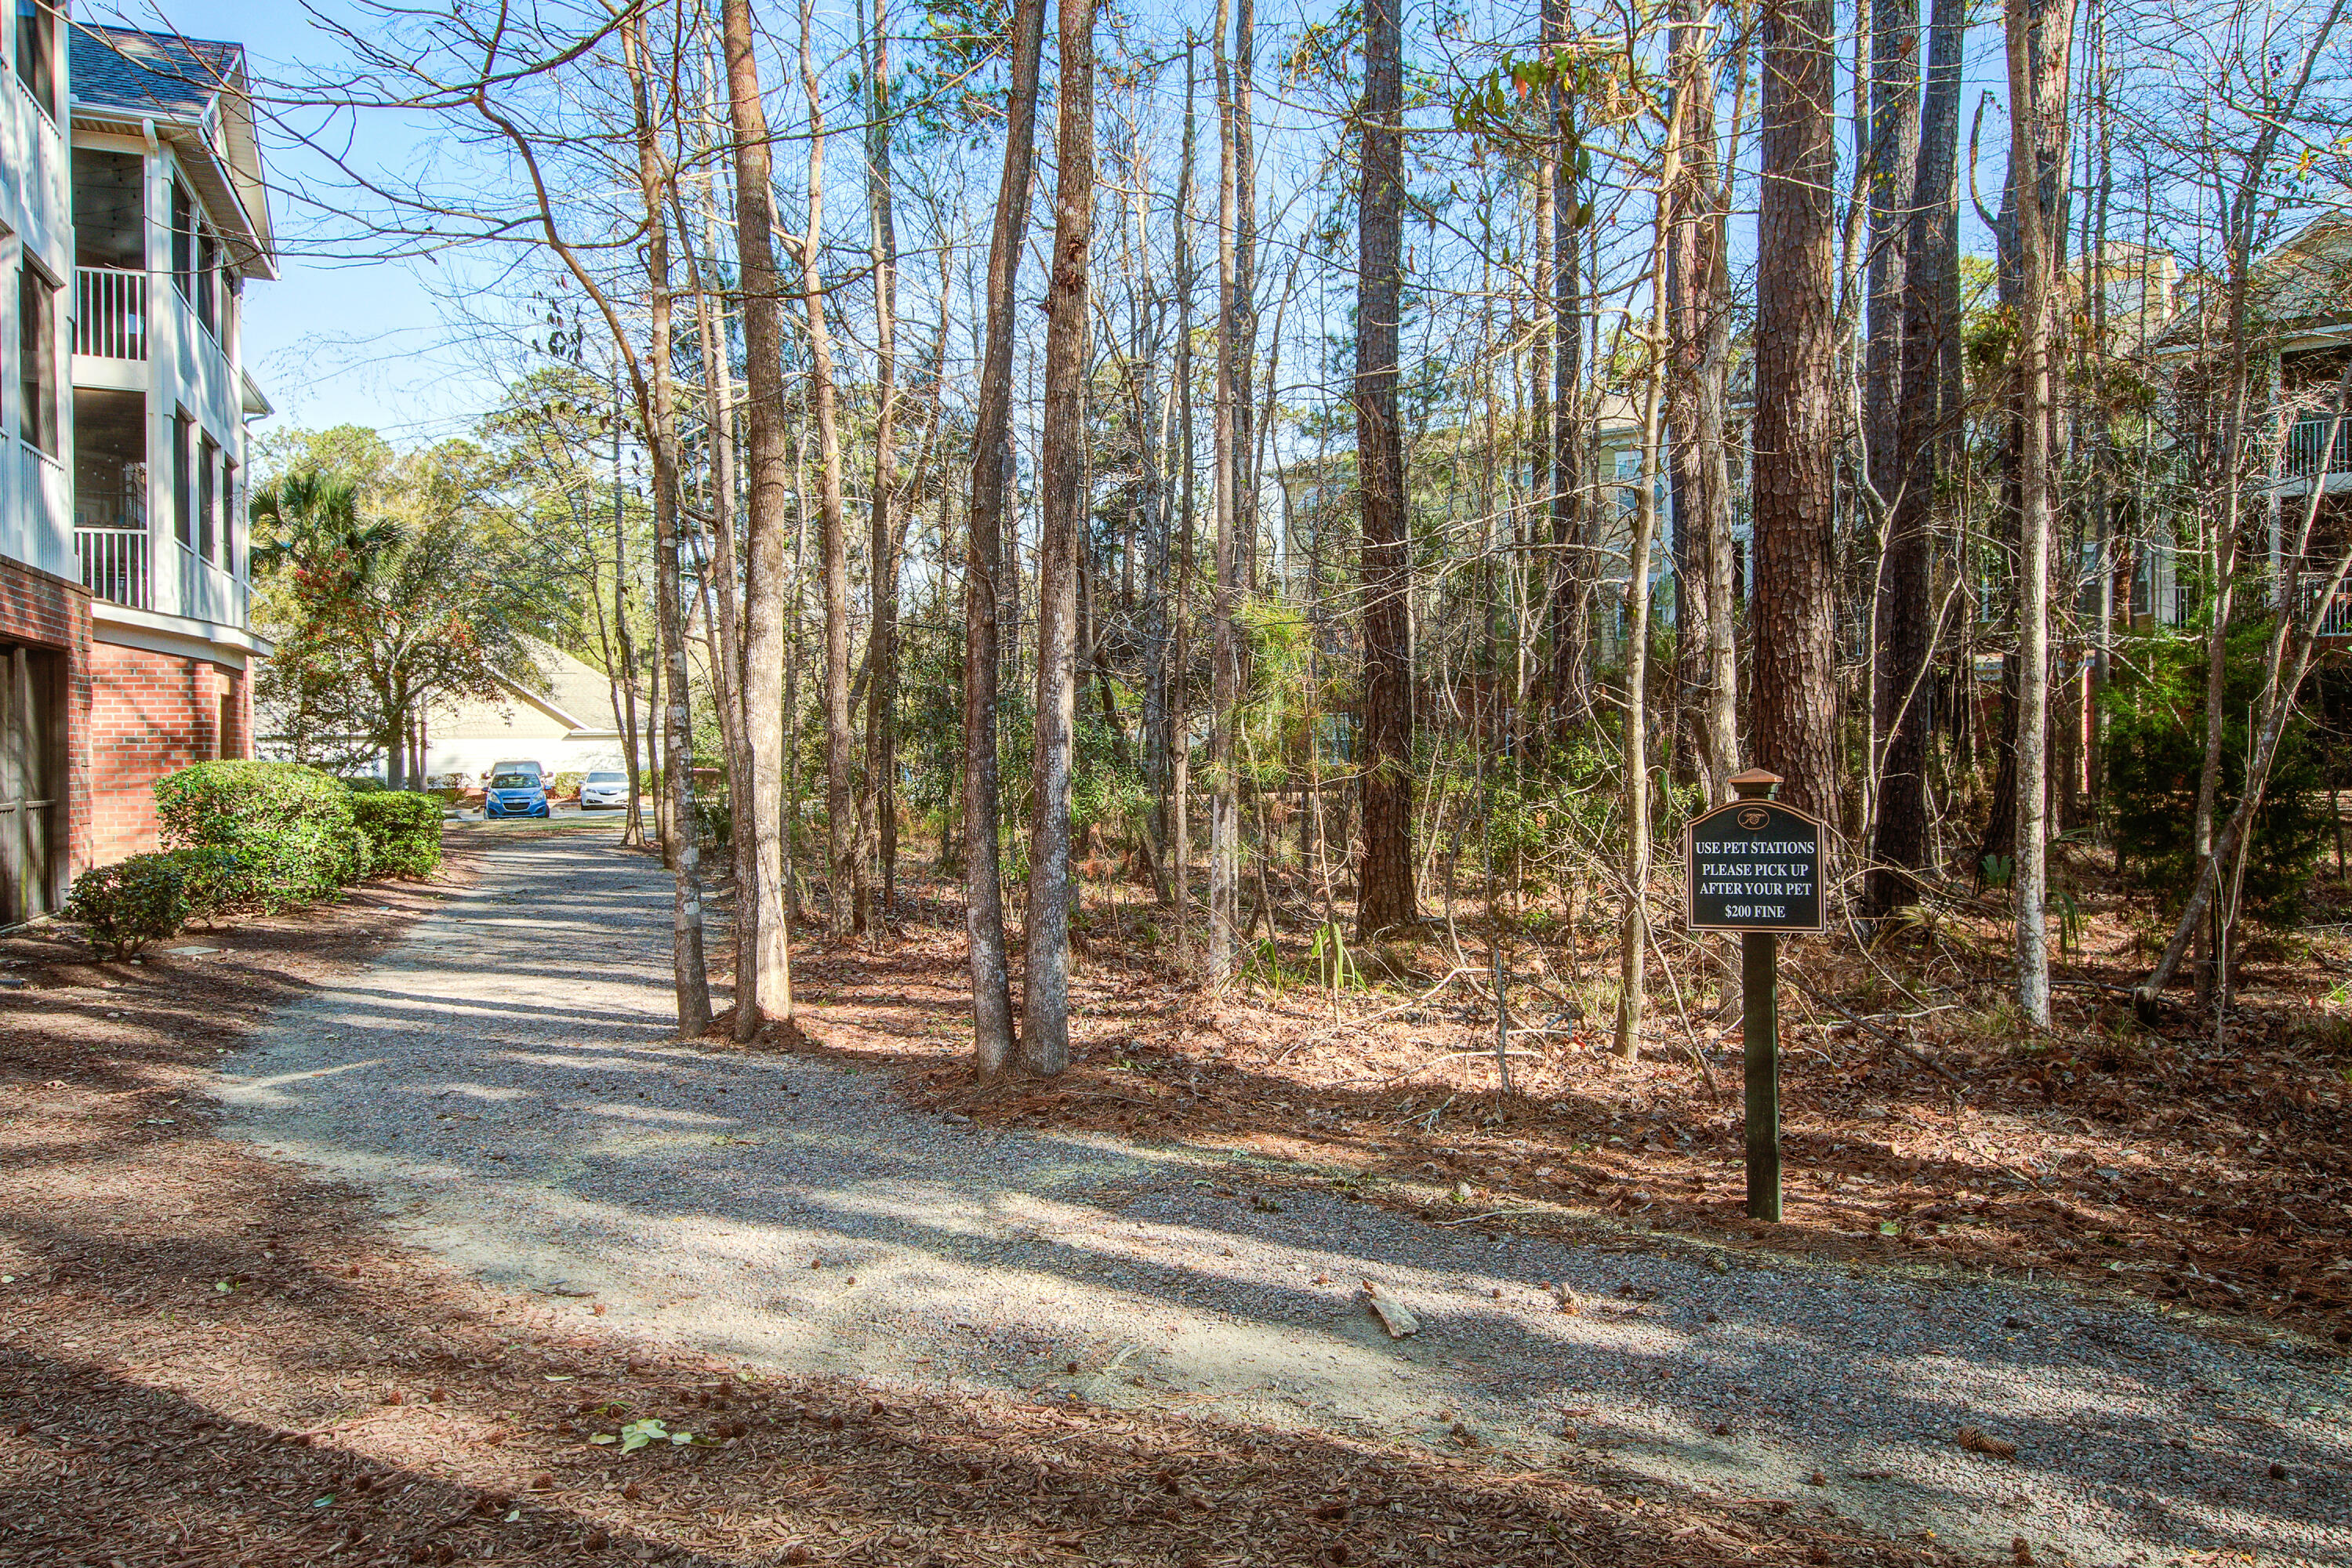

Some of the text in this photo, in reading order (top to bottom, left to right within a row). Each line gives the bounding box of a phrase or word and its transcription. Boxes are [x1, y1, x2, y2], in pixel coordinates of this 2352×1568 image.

[1696, 842, 1814, 854] USE PET STATIONS
[1702, 864, 1809, 876] PLEASE PICK UP
[1700, 883, 1812, 895] AFTER YOUR PET
[1725, 904, 1785, 918] $200 FINE
